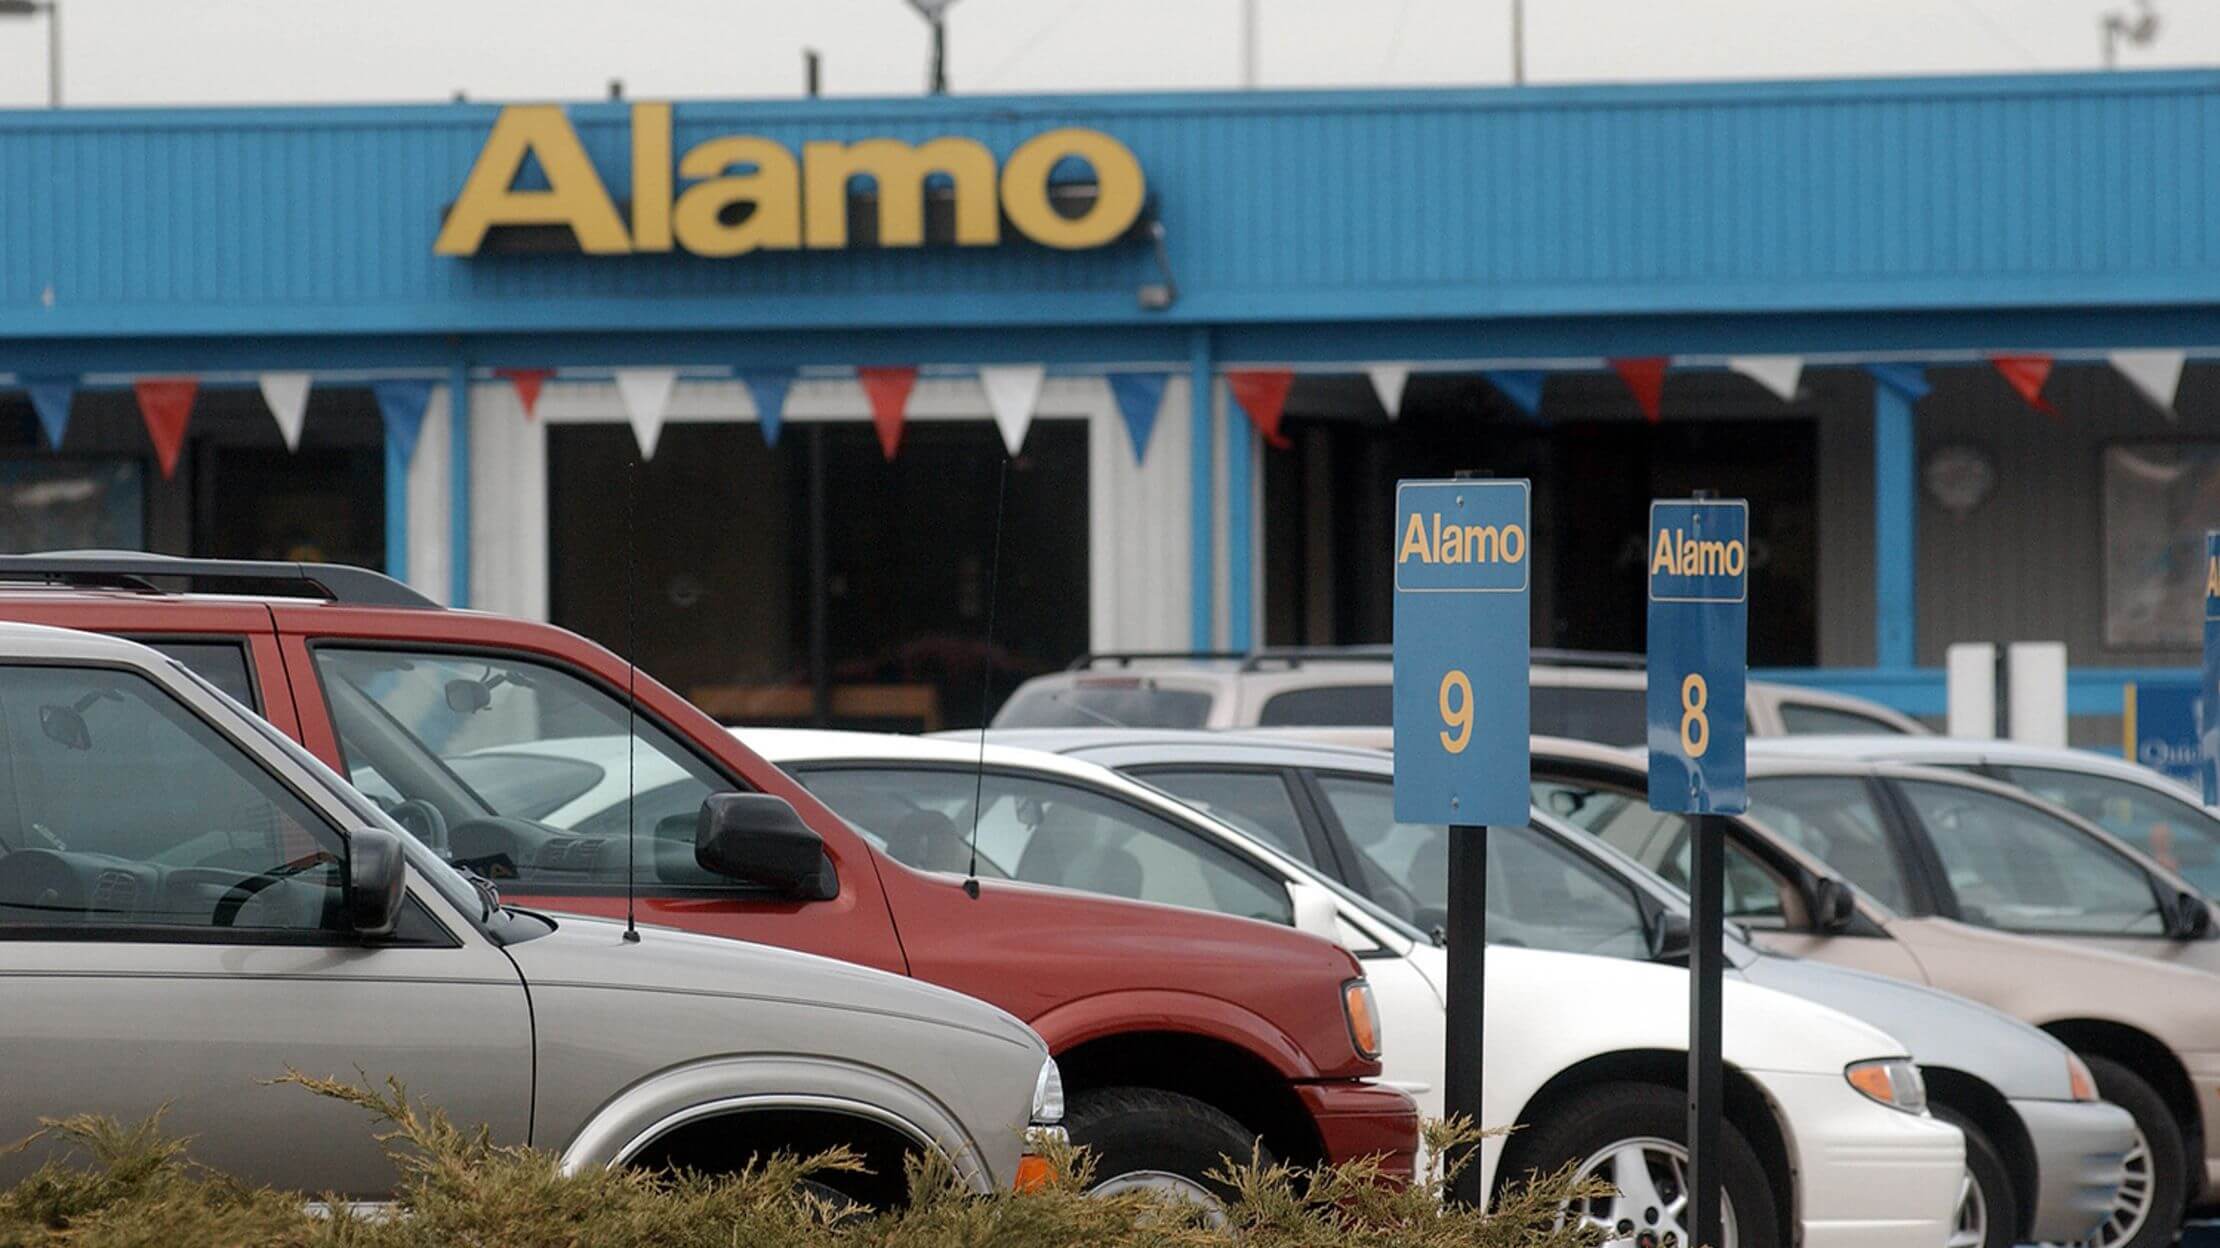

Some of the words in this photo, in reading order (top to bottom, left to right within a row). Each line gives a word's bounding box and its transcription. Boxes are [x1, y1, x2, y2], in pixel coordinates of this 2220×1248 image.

[433, 101, 1146, 258] Alamo
[1398, 512, 1526, 565] Alamo
[1650, 528, 1746, 577] Alamo
[2205, 556, 2220, 597] A
[1438, 669, 1475, 755] 9
[1680, 672, 1711, 759] 8
